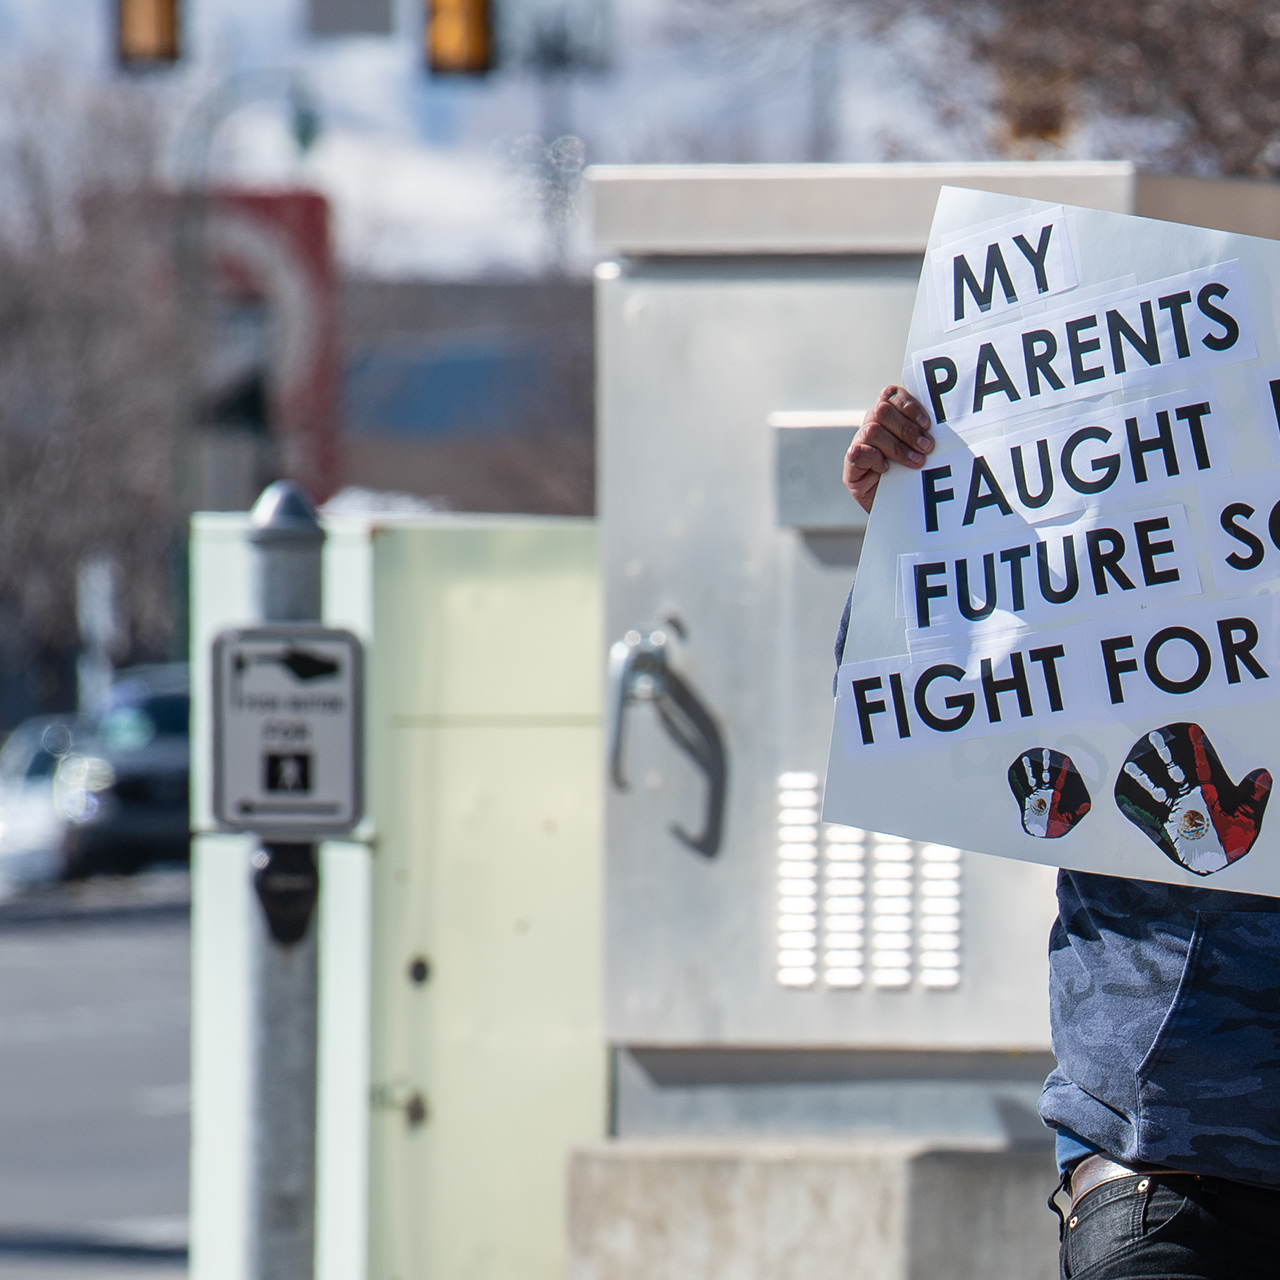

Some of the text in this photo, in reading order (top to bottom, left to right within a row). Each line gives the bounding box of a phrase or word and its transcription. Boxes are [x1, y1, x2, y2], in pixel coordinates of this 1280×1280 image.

[954, 224, 1053, 322] MY
[922, 282, 1240, 425] PARENTS
[921, 401, 1212, 533] FAUGHT
[913, 516, 1180, 629] FUTURE
[851, 644, 1065, 746] FIGHT
[1100, 617, 1270, 705] FOR
